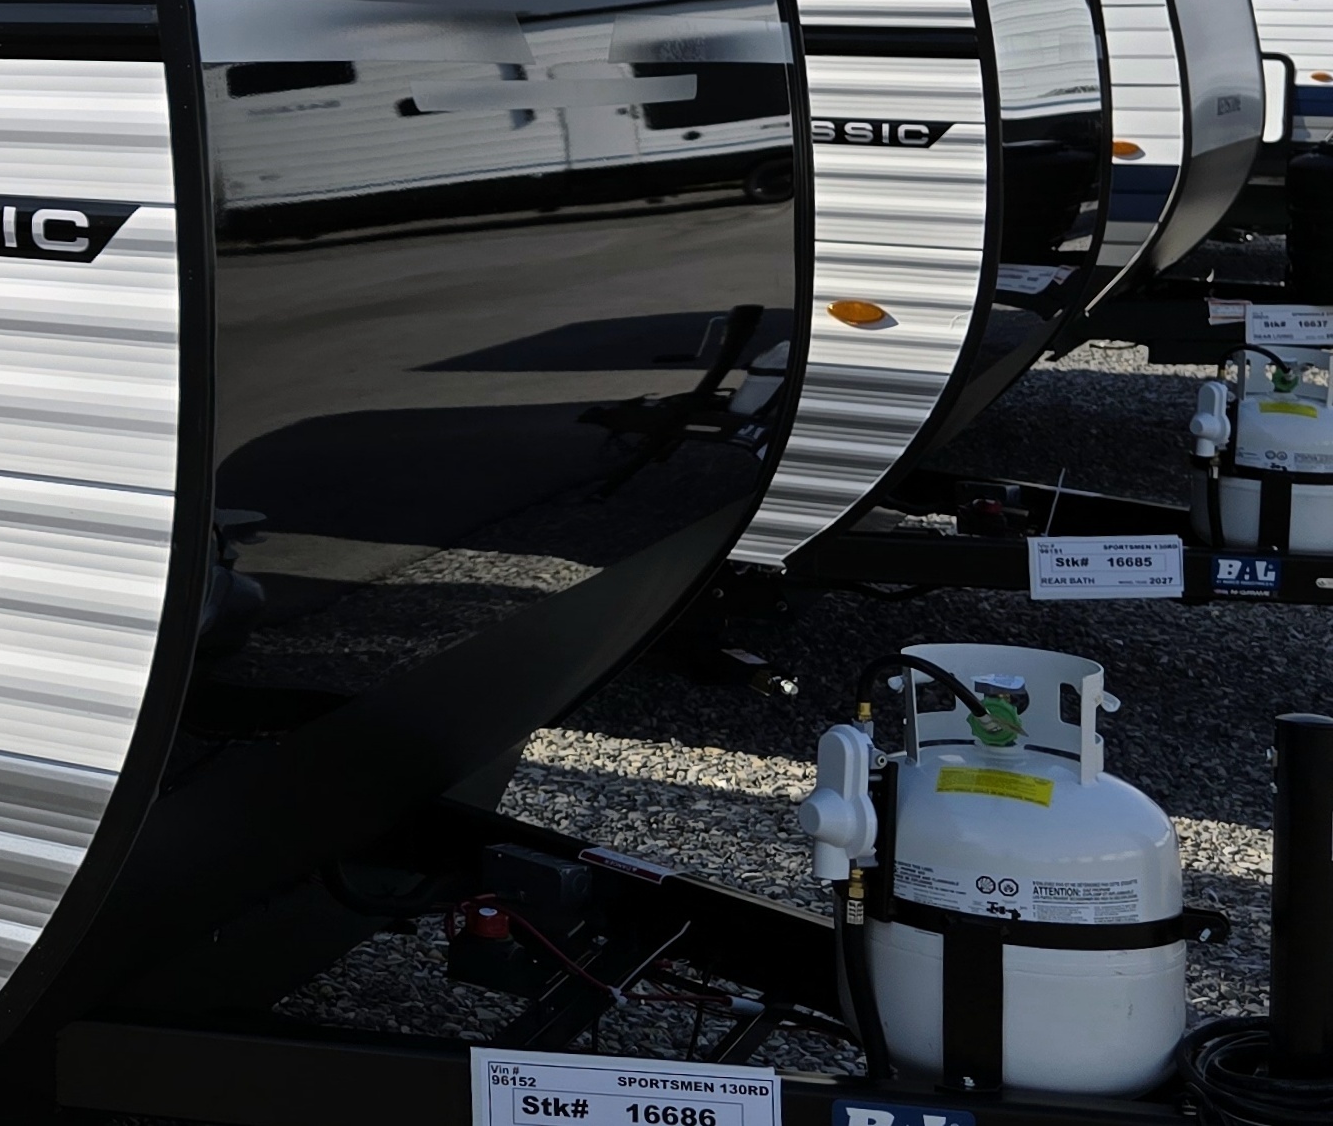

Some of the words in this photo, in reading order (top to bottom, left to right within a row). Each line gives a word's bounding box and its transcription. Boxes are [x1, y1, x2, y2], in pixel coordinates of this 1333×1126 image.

[1055, 557, 1090, 567] Stk#
[1107, 557, 1153, 567] 16685
[1040, 577, 1067, 585] REAR
[1069, 577, 1095, 585] BATH
[1149, 577, 1174, 585] 2027
[1033, 886, 1081, 897] ATTENTION:
[491, 1065, 510, 1074] Vin
[491, 1075, 537, 1087] 96152
[617, 1076, 715, 1093] SPORTSMEN
[719, 1083, 770, 1096] 130RD
[521, 1095, 589, 1119] Stk#
[625, 1103, 716, 1126] 16686
